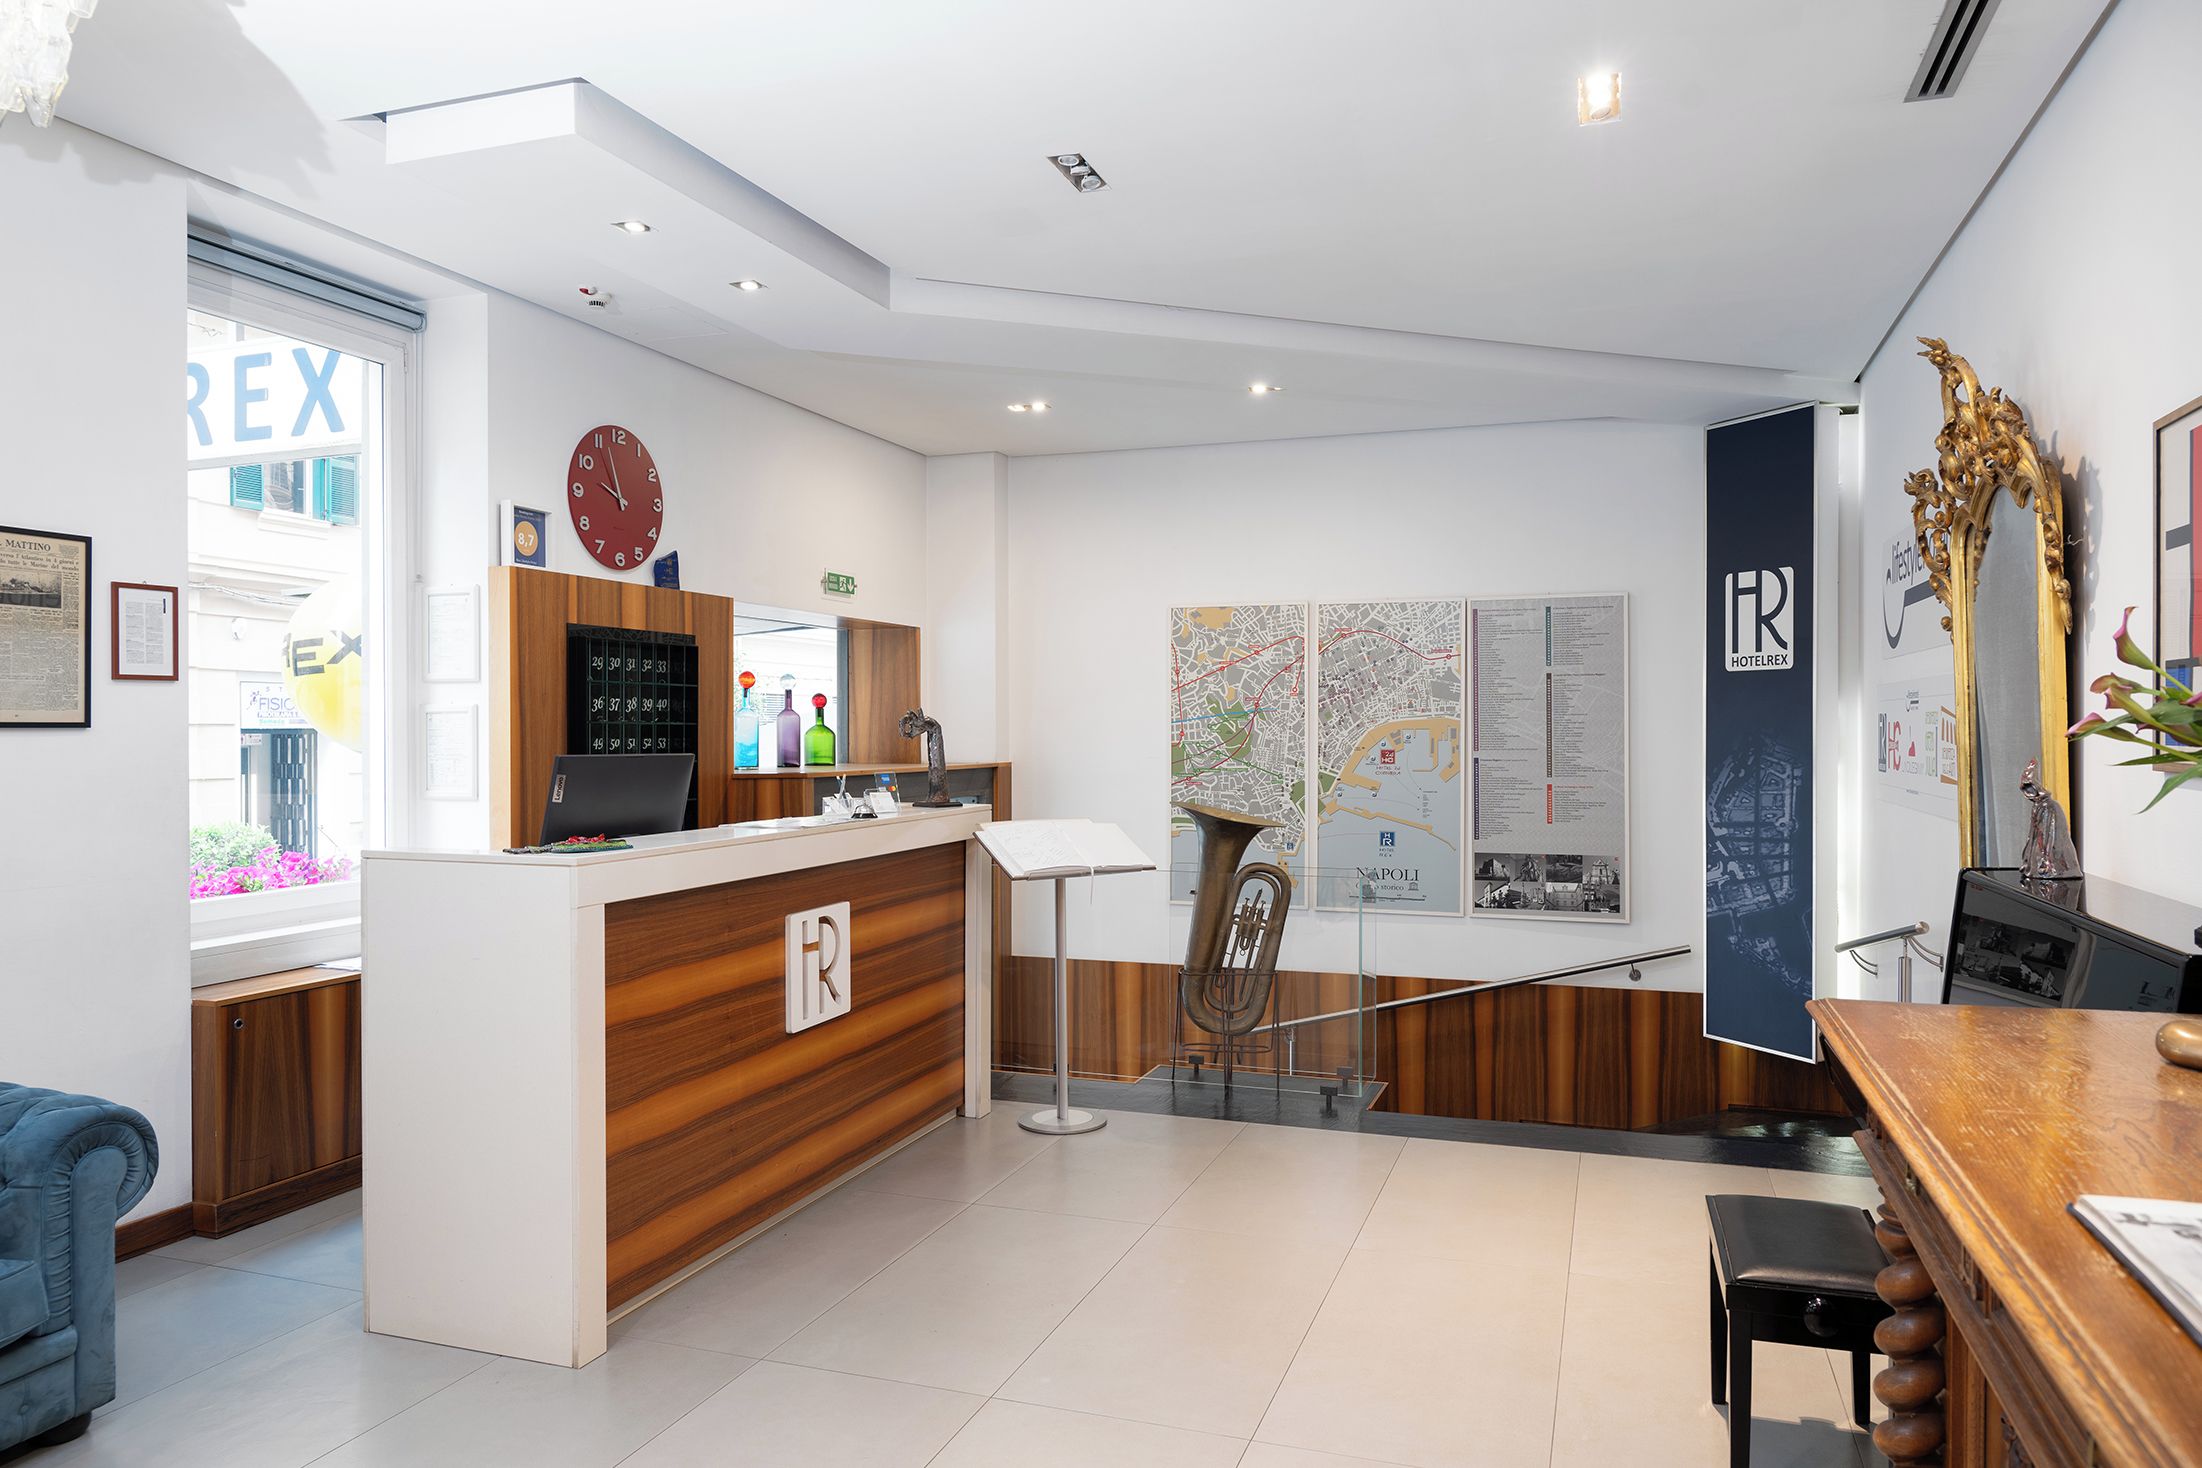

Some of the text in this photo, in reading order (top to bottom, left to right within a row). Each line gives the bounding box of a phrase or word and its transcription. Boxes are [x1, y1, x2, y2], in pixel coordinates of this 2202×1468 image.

[187, 347, 345, 446] REX
[594, 433, 603, 449] 11
[612, 428, 626, 445] 12
[637, 443, 641, 458] 1
[579, 453, 594, 470] 10
[647, 468, 657, 483] 2
[572, 482, 584, 498] 9
[653, 498, 663, 513] 3
[579, 515, 590, 531] 8
[518, 532, 535, 548] 8,7
[647, 527, 658, 541] 4
[5, 539, 51, 552] MATTINO
[594, 539, 605, 554] 7
[615, 552, 625, 567] 6
[634, 547, 644, 562] 5
[282, 630, 361, 677] EX
[1731, 654, 1788, 667] HOTELREX
[592, 656, 667, 673] 29 30 31 32 33
[591, 696, 668, 713] 36 37 38 39 40
[593, 738, 666, 750] 49 50 51 52 53
[554, 776, 564, 801] Lenovo
[1356, 867, 1420, 882] NAPOLI
